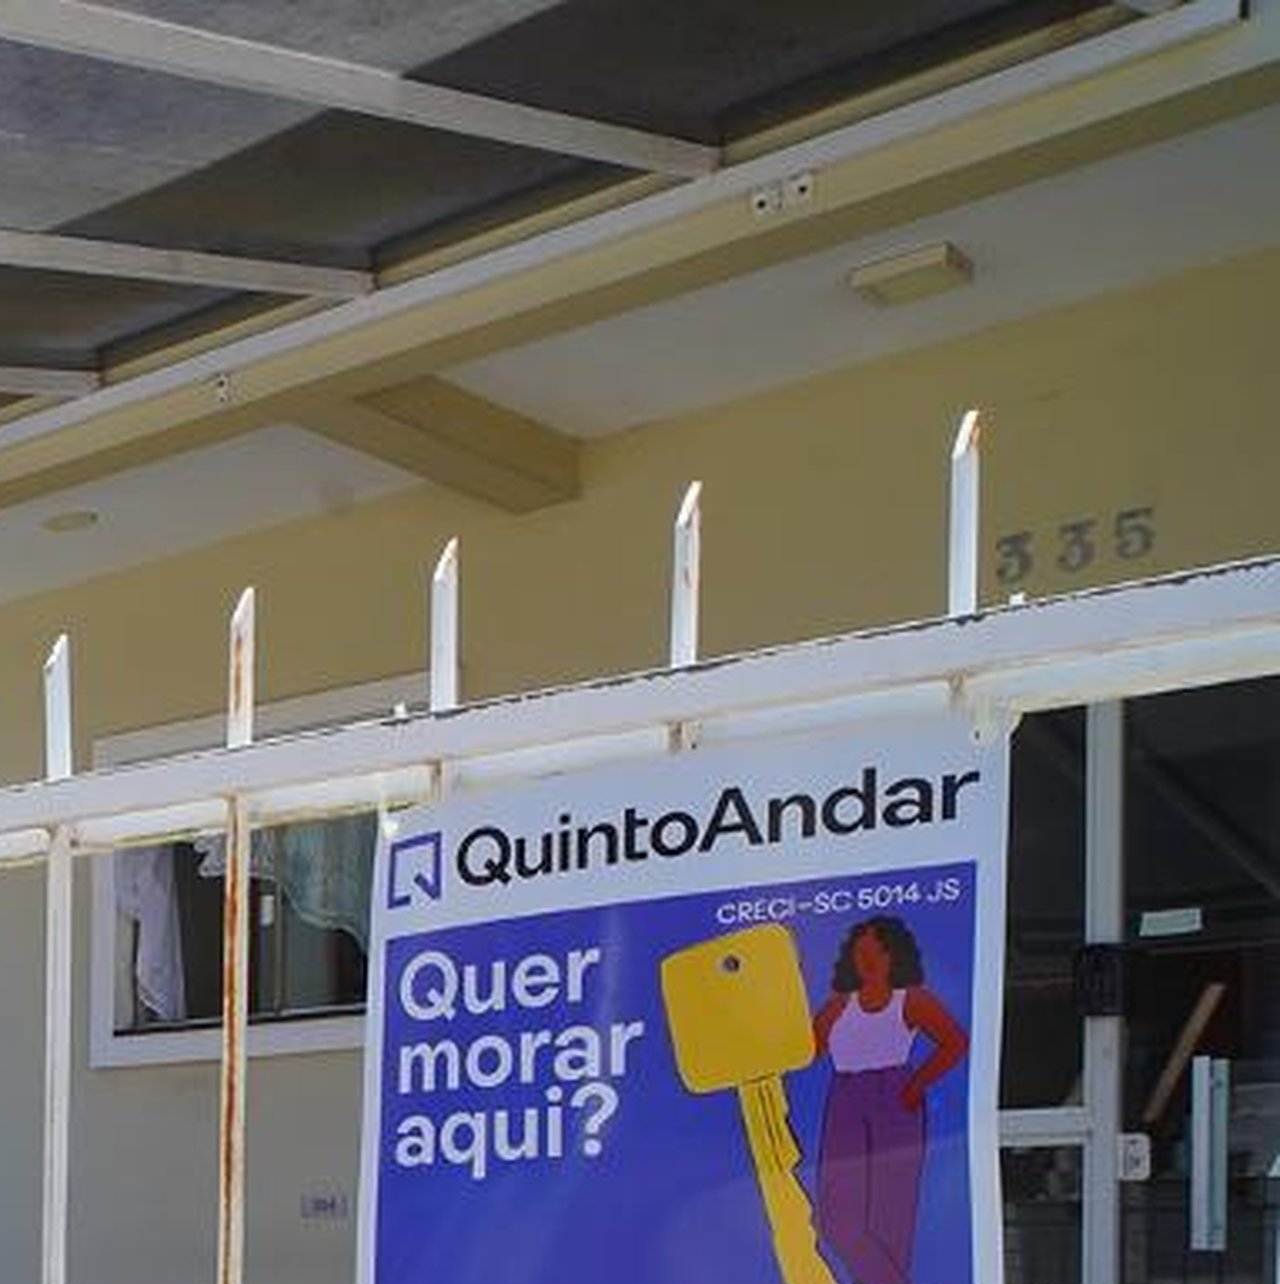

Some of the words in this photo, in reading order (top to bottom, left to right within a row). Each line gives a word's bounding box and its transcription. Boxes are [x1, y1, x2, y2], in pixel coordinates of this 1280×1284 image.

[994, 506, 1155, 584] 335
[454, 766, 981, 889] QuintoAndar
[715, 891, 853, 924] CRECI-SC
[857, 882, 921, 909] 5014
[926, 877, 961, 903] JS
[398, 947, 600, 1021] Quer
[396, 1017, 645, 1095] morar
[393, 1082, 620, 1179] aqui?
